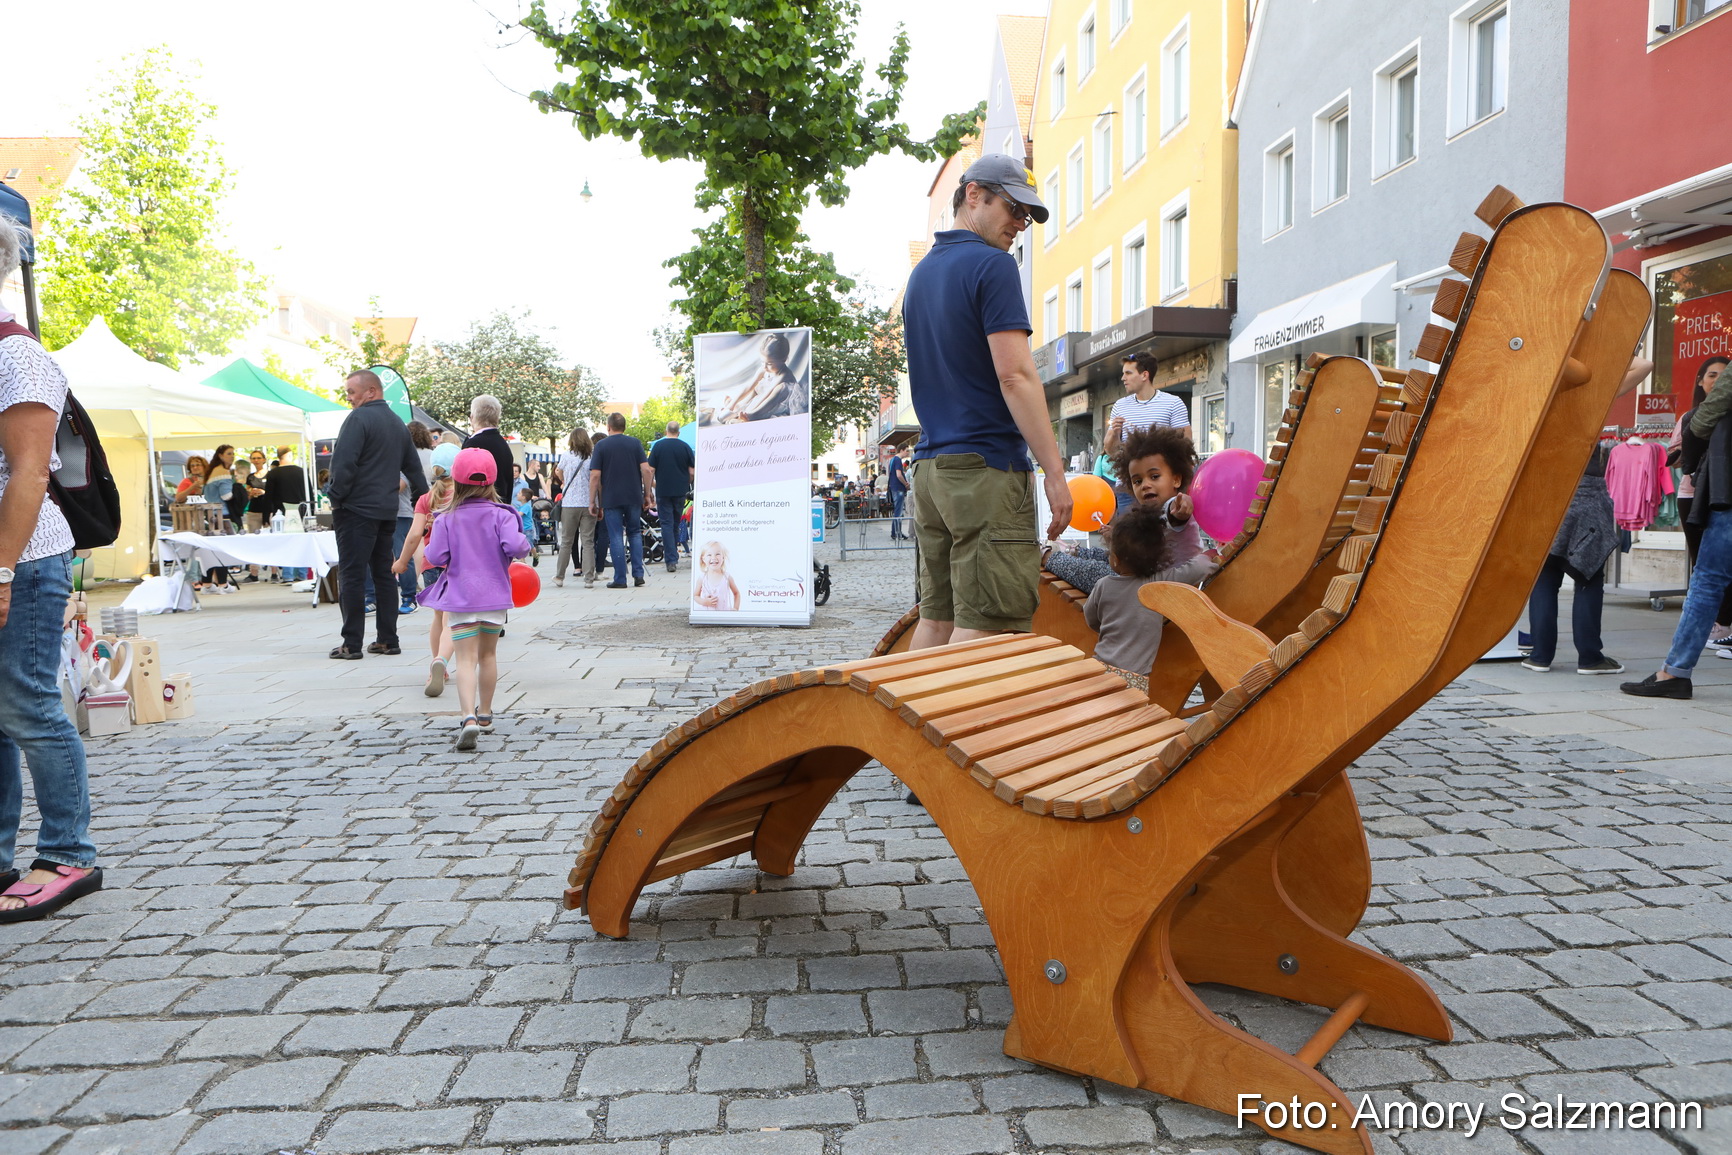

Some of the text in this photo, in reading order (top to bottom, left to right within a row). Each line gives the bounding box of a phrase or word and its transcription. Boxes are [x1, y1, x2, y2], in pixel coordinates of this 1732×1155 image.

[1254, 315, 1325, 351] FRAUENZIMMER
[1687, 312, 1722, 335] PREIS
[1090, 329, 1127, 355] Bavaria-Kino
[1679, 335, 1728, 359] RUTSCH
[1645, 398, 1669, 410] 30%
[701, 439, 717, 453] Wo
[720, 435, 757, 451] Träume
[708, 460, 726, 473] und
[728, 455, 764, 470] wachsen
[702, 499, 790, 508] Ballett & Kindertanzen
